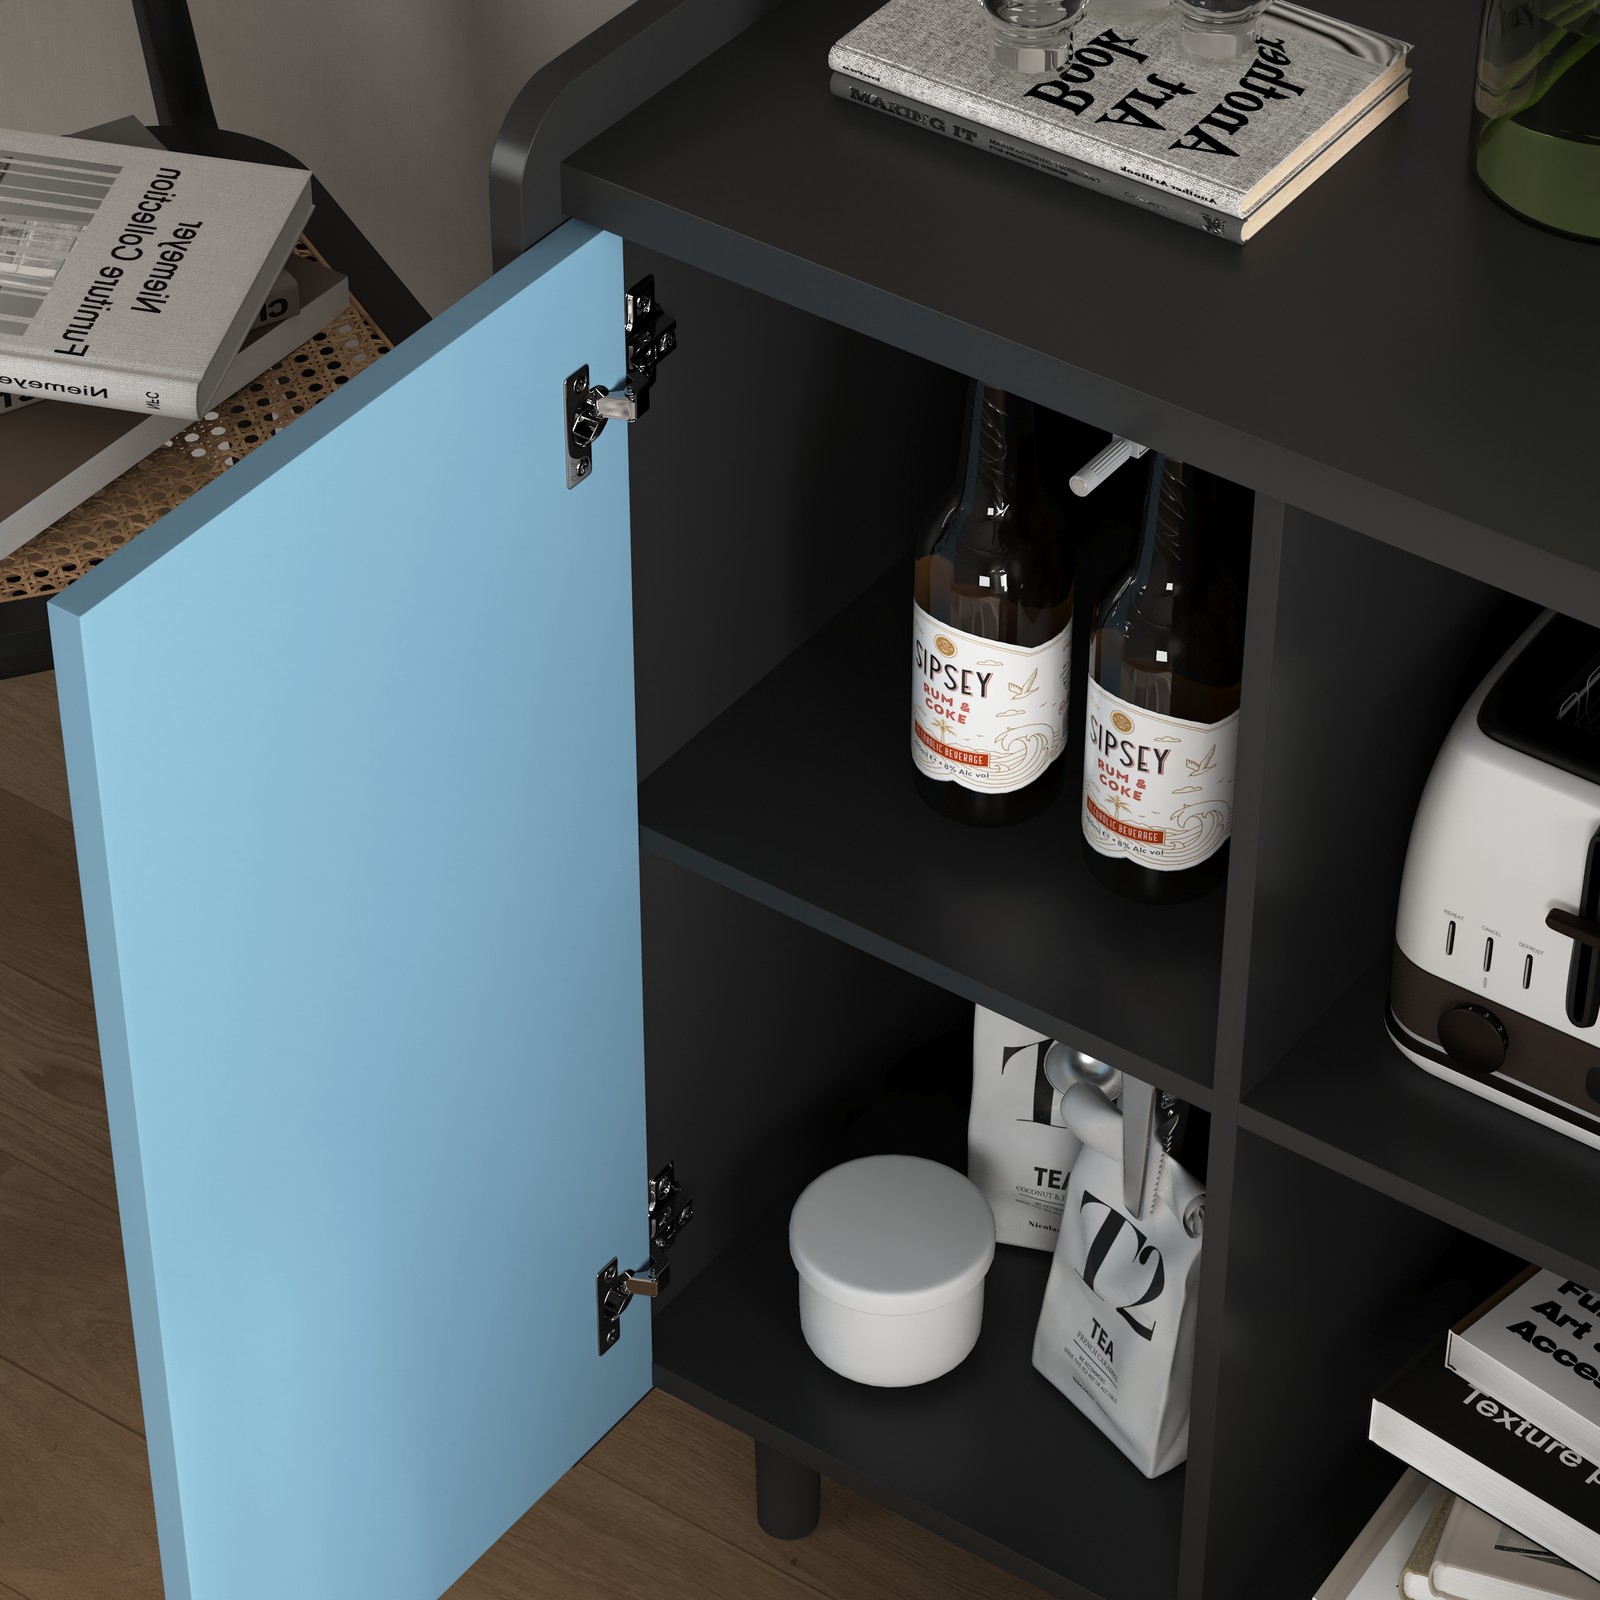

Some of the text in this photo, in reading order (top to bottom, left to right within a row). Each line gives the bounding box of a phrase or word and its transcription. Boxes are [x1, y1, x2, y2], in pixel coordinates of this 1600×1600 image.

[850, 86, 977, 143] MAKING IT
[916, 639, 993, 698] SIPSEY
[923, 682, 971, 713] RUM &
[925, 697, 967, 725] COKE
[944, 747, 983, 765] BEVERAGE
[1090, 714, 1171, 775] SIPSEY
[943, 763, 957, 773] 8%
[958, 769, 973, 777] Alc
[1097, 757, 1147, 790] RUM &
[1099, 773, 1142, 801] COKE
[1118, 822, 1159, 842] BEVERAGE
[1117, 840, 1131, 850] 8%
[1132, 846, 1147, 854] Alc
[1443, 909, 1464, 921] REHEAT
[1481, 925, 1501, 937] CANCEL
[1518, 941, 1544, 956] DEFROST
[1015, 1185, 1054, 1199] COCONUT
[1074, 1189, 1165, 1342] T2
[1557, 1280, 1600, 1318] Fu
[1530, 1300, 1593, 1340] Art
[1076, 1330, 1098, 1356] FRENCH
[1091, 1317, 1114, 1363] TEA
[1462, 1383, 1582, 1468] Texture
